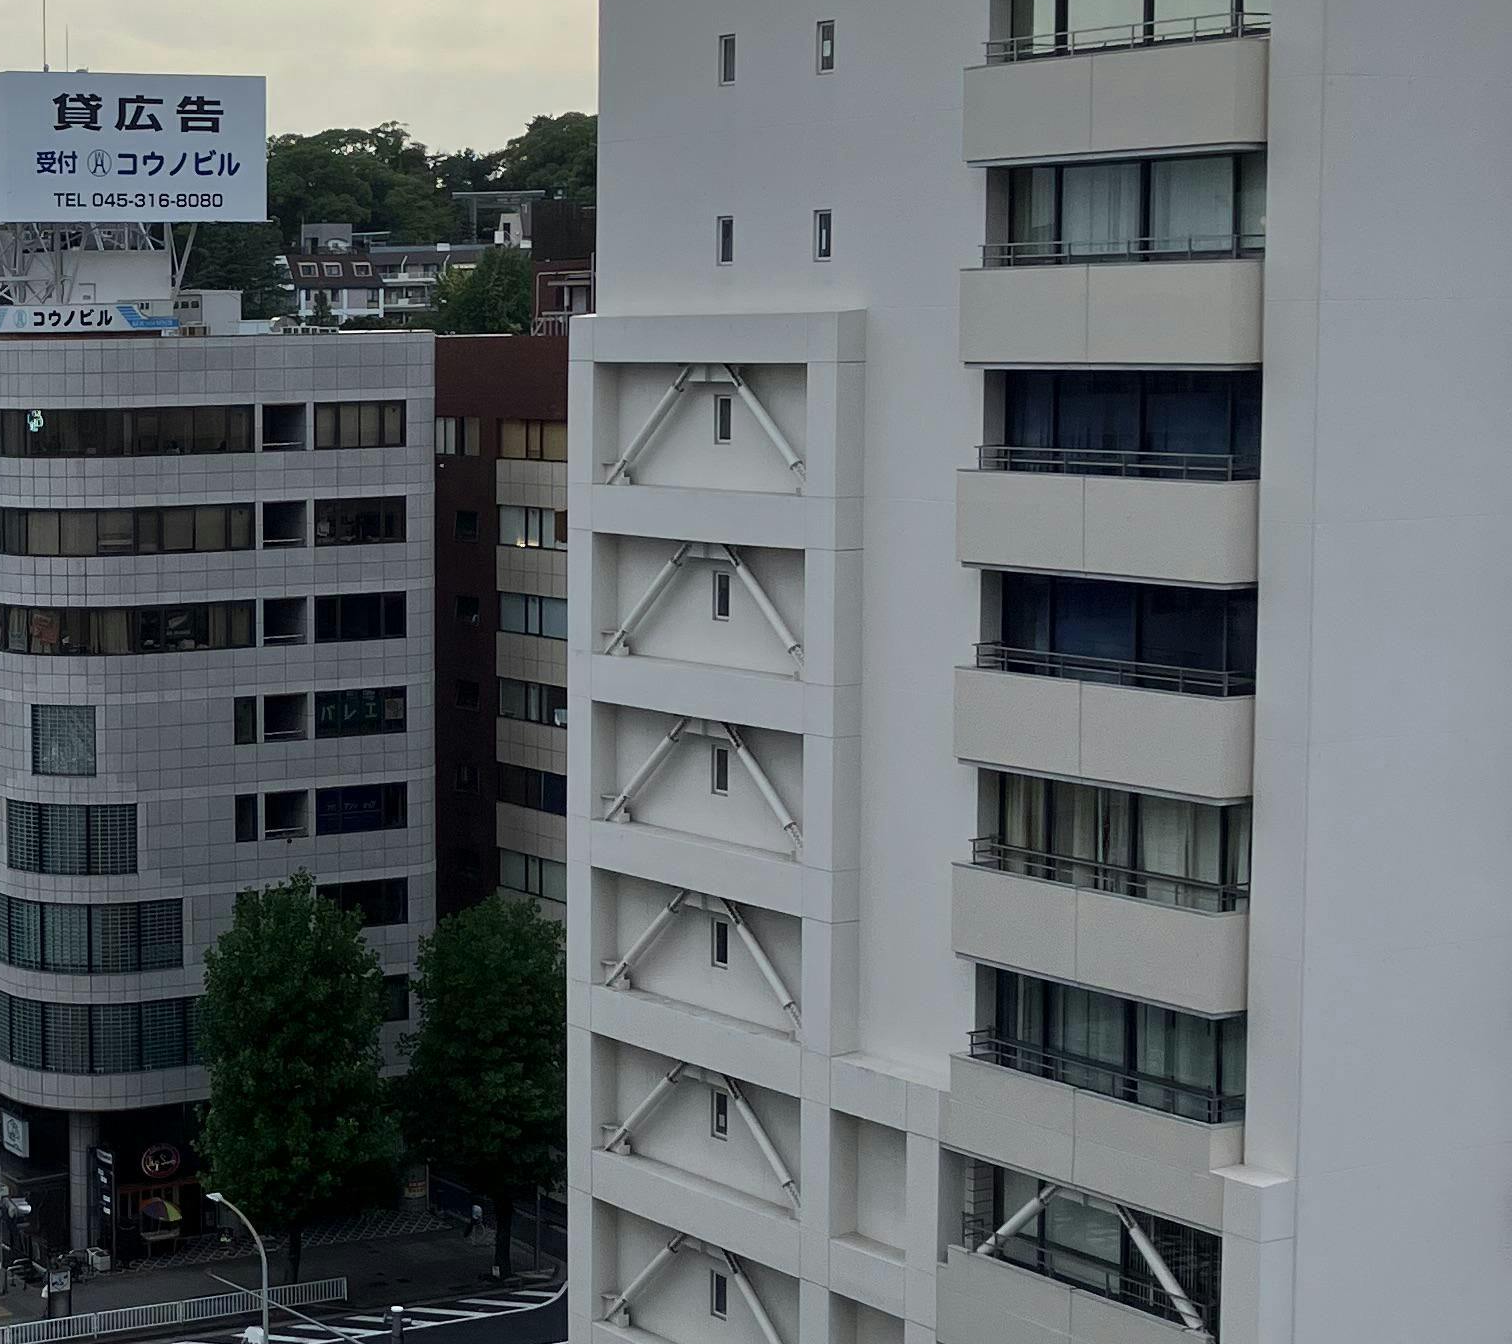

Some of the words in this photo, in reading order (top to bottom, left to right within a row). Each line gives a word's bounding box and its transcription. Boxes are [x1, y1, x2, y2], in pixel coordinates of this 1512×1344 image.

[52, 92, 225, 133] 貸広告
[36, 150, 78, 175] 受付
[116, 149, 241, 178] コウノビル
[53, 192, 87, 208] TEL
[91, 192, 224, 208] 045-316-8080
[33, 308, 112, 327] コウノビル
[320, 702, 378, 721] バレエ
